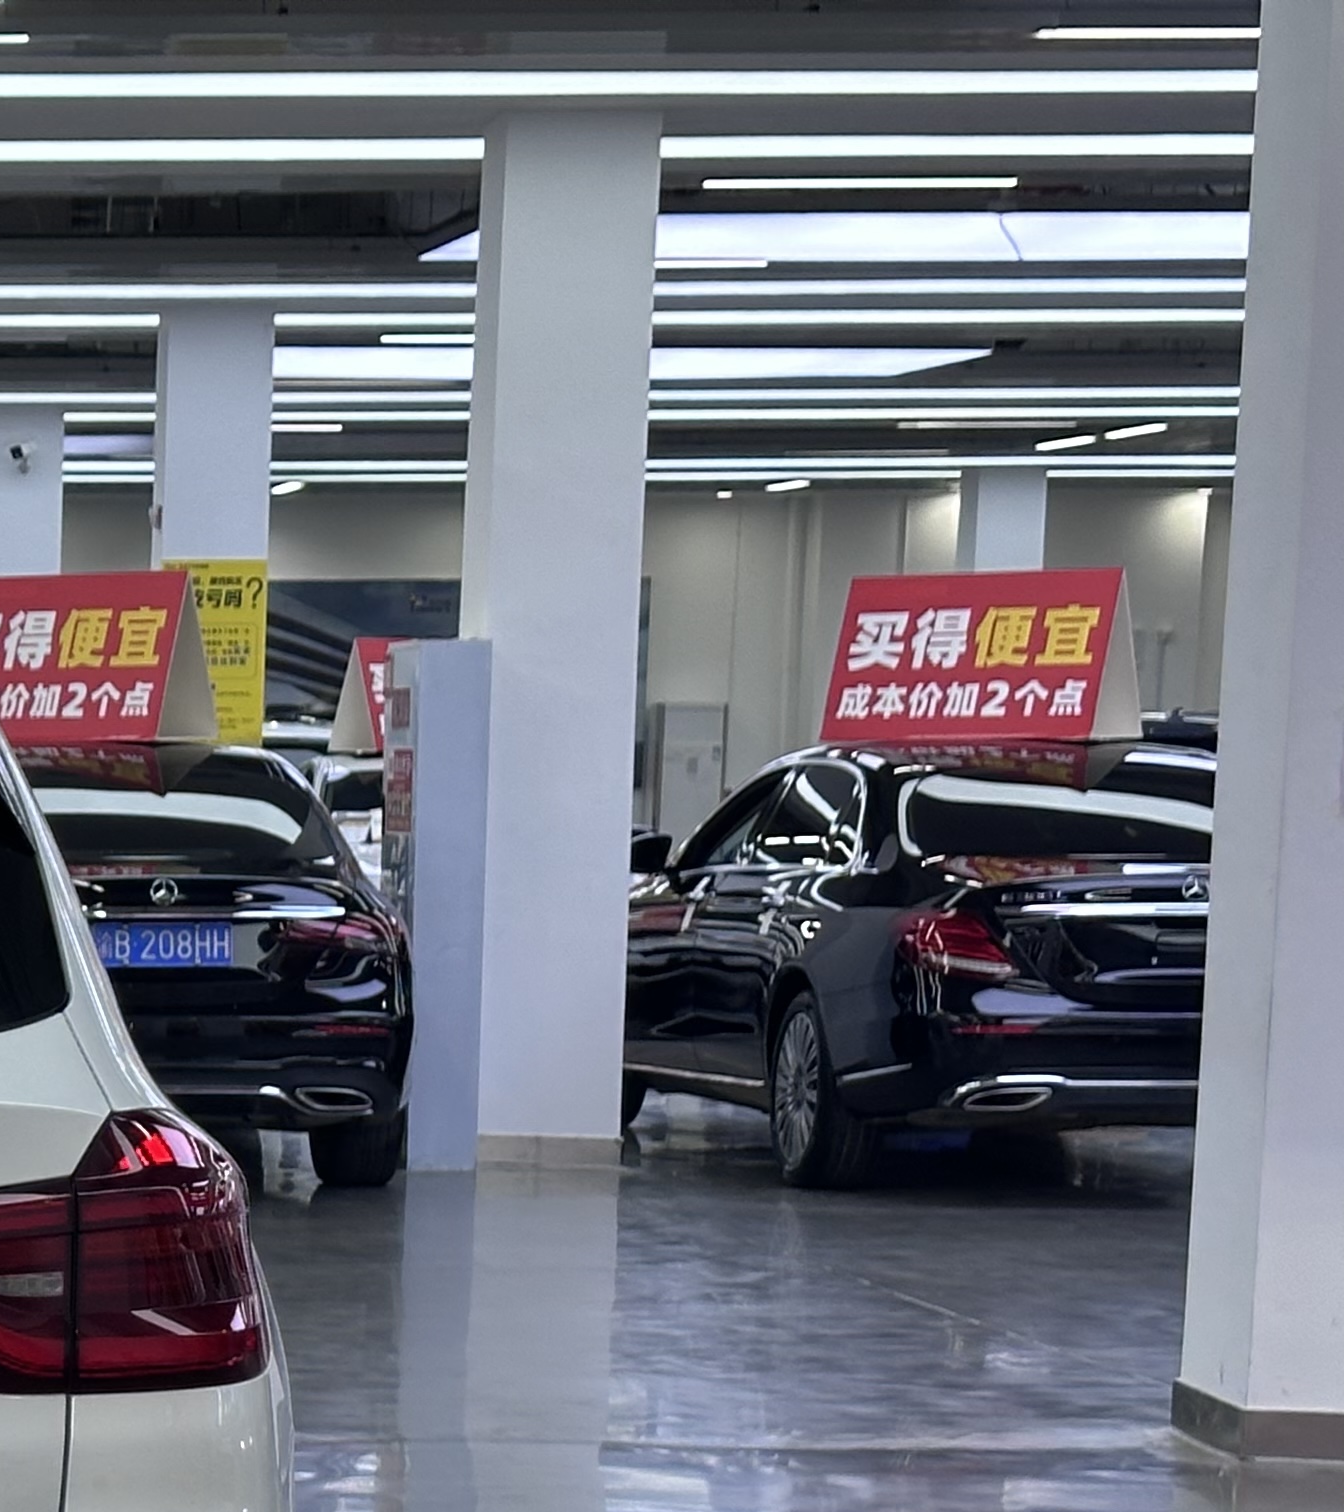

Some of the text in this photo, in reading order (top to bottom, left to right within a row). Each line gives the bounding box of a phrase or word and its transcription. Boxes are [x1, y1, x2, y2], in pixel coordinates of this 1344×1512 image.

[847, 603, 1101, 672] 买得便宜
[836, 679, 1087, 720] 成本价加2个点
